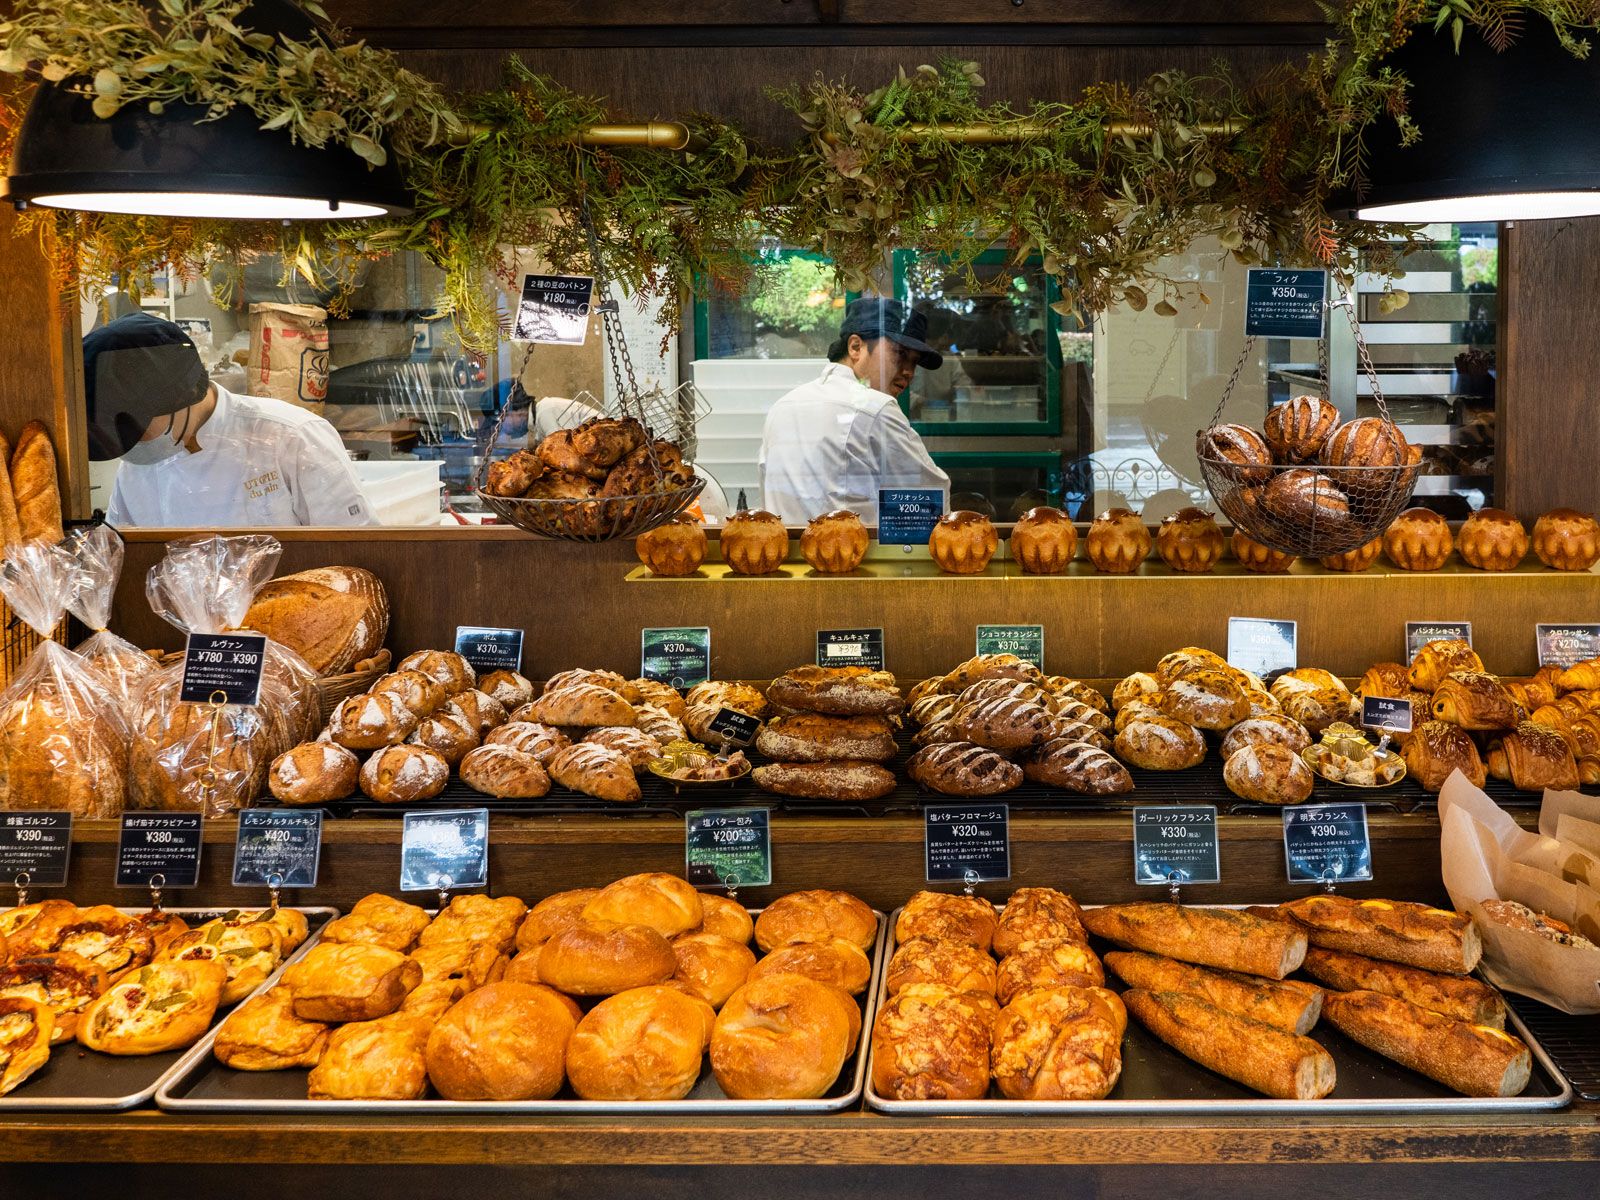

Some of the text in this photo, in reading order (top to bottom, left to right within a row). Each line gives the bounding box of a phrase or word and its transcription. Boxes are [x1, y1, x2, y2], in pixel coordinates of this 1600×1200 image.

[1275, 275, 1299, 284] フィグ
[543, 292, 566, 303] ¥180
[1271, 287, 1296, 298] ¥350
[899, 503, 920, 513] ¥200
[830, 633, 871, 641] キュルキュマ
[1549, 629, 1590, 637] クロワッサン
[211, 640, 244, 649] ルヴァン
[476, 644, 498, 654] ¥370
[663, 643, 685, 653] ¥370
[998, 640, 1019, 650] ¥370
[1558, 639, 1579, 649] ¥270
[197, 651, 223, 663] ¥780
[233, 653, 258, 665] ¥390
[6, 817, 57, 826] 蜂蜜ゴルゴン
[244, 818, 317, 826] レモンタルタルチキン
[702, 816, 753, 827] 塩バター包み
[930, 812, 1002, 822] 塩バターフロマージュ
[1139, 814, 1211, 823] ガーリックフランス
[1300, 812, 1348, 822] 明太フランス
[125, 819, 198, 827] 揚げ茄子アラビアータ
[16, 829, 42, 842] ¥390
[951, 825, 978, 837] ¥320
[1160, 826, 1187, 838] ¥330
[1310, 824, 1337, 837] ¥390
[146, 831, 172, 843] ¥380
[264, 830, 290, 842] ¥420
[713, 830, 739, 842] ¥200
